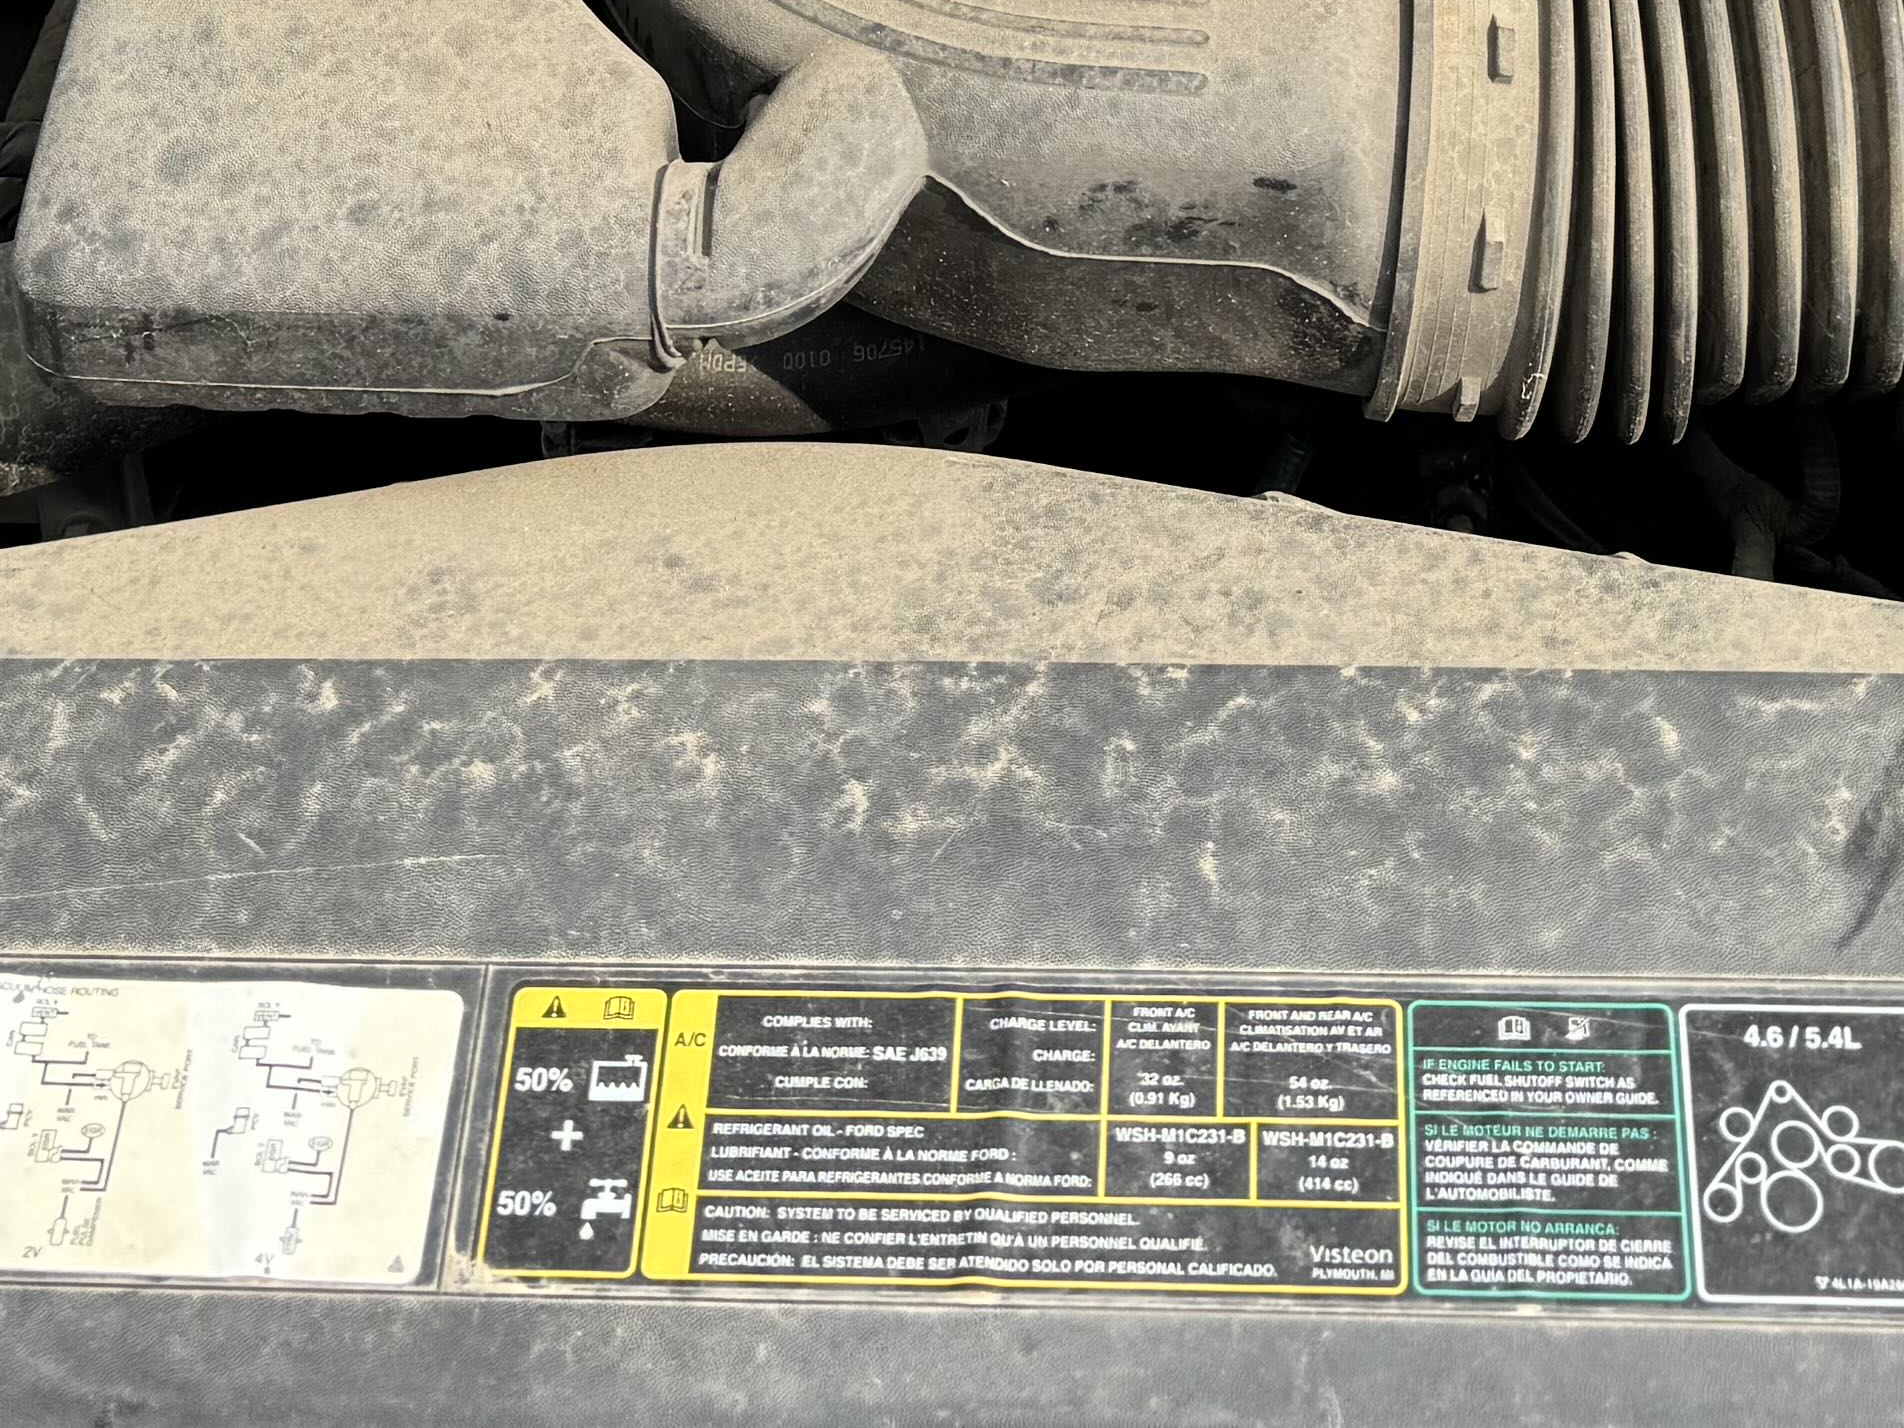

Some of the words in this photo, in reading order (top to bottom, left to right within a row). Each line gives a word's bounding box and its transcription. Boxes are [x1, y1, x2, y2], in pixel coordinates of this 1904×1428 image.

[70, 987, 119, 997] ROUTING
[1133, 1007, 1172, 1018] FRONT
[1175, 1007, 1195, 1019] A/C
[1248, 1010, 1287, 1021] FRONT
[1290, 1010, 1316, 1021] AND
[1318, 1010, 1351, 1022] REAR
[762, 1015, 832, 1028] COMPLIES
[834, 1016, 872, 1029] WITH:
[990, 1017, 1047, 1031] CHARGE
[1049, 1019, 1096, 1032] LEVEL:
[674, 1032, 707, 1048] A/C
[1743, 1025, 1790, 1048] 4.6
[1804, 1026, 1862, 1049] 5.4L
[719, 1044, 789, 1058] CONFORME
[802, 1046, 820, 1058] LA
[873, 1046, 906, 1061] SAE
[910, 1046, 947, 1062] J639
[1033, 1049, 1095, 1062] CHARGE:
[1423, 1059, 1434, 1071] IF
[1438, 1059, 1490, 1072] ENGINE
[1493, 1059, 1532, 1072] FAILS
[1536, 1059, 1555, 1072] TO
[1558, 1060, 1605, 1073] START:
[514, 1067, 574, 1093] 50%
[775, 1076, 831, 1089] CUMPLE
[834, 1076, 868, 1089] CON:
[965, 1077, 1008, 1091] CARGA
[1011, 1078, 1028, 1090] DE
[1030, 1078, 1094, 1093] LLENADO:
[1142, 1073, 1159, 1086] 32
[1289, 1076, 1308, 1089] 54
[1422, 1074, 1467, 1087] CHECK
[1470, 1074, 1501, 1088] FUEL
[1504, 1075, 1563, 1088] SHUTOFF
[1565, 1075, 1616, 1089] SWITCH
[1618, 1076, 1636, 1089] AS
[1129, 1092, 1165, 1108] (0.91
[1167, 1092, 1195, 1108] Kg)
[1277, 1095, 1314, 1111] (1.53
[1317, 1095, 1345, 1111] Kg)
[1423, 1089, 1508, 1103] REFERENCED
[1511, 1090, 1523, 1103] IN
[1526, 1091, 1564, 1104] YOUR
[1567, 1091, 1612, 1105] OWNER
[1615, 1091, 1659, 1106] GUIDE.
[713, 1124, 809, 1137] REFRIGERANT
[812, 1125, 834, 1137] OIL
[845, 1126, 882, 1137] FORD
[886, 1126, 924, 1138] SPEC
[1115, 1128, 1246, 1145] WSH-M1C231-B
[1424, 1125, 1436, 1137] SI
[1439, 1125, 1457, 1137] LE
[1461, 1125, 1522, 1138] MOTEUR
[1525, 1126, 1545, 1138] NE
[1619, 1127, 1649, 1140] PAS
[1262, 1131, 1394, 1149] WSH-M1C231-B
[1492, 1140, 1510, 1154] LA
[1513, 1140, 1593, 1155] COMMANDE
[1598, 1142, 1619, 1155] DE
[1163, 1151, 1173, 1164] 9
[1177, 1154, 1195, 1164] oz
[1309, 1155, 1326, 1169] 14
[1330, 1158, 1348, 1169] oz
[1425, 1155, 1493, 1169] COUPURE
[1497, 1156, 1517, 1169] DE
[1615, 1157, 1669, 1172] COMME
[1149, 1173, 1181, 1189] (266
[1184, 1173, 1210, 1189] cc)
[1299, 1177, 1330, 1193] (414
[1334, 1177, 1359, 1193] cc)
[496, 1190, 557, 1217] 50%
[1426, 1188, 1555, 1203] L'AUTOMOBILISTE.
[704, 1206, 770, 1219] CAUTION:
[777, 1206, 833, 1220] SYSTEM
[836, 1207, 855, 1220] TO
[858, 1208, 877, 1220] BE
[880, 1208, 949, 1222] SERVICED
[953, 1209, 973, 1222] BY
[975, 1208, 1048, 1224] QUALIFIED
[1051, 1211, 1140, 1225] PERSONNEL.
[1427, 1220, 1439, 1233] SI
[1443, 1220, 1460, 1233] LE
[1464, 1221, 1517, 1234] MOTOR
[1520, 1221, 1542, 1235] NO
[1544, 1222, 1619, 1236] ARRANCA:
[1426, 1236, 1475, 1250] REVISE
[1478, 1237, 1496, 1250] EL
[1499, 1237, 1593, 1251] INTERRUPTOR
[1597, 1238, 1617, 1251] DE
[1620, 1238, 1672, 1253] CIERRE
[1309, 1246, 1393, 1265] Visteon
[801, 1255, 818, 1268] EL
[821, 1255, 883, 1269] SISTEMA
[887, 1256, 925, 1269] DEBE
[928, 1256, 956, 1270] SER
[958, 1257, 1029, 1272] ATENDIDO
[1032, 1260, 1067, 1273] SOLO
[1071, 1261, 1106, 1274] POR
[1109, 1261, 1185, 1275] PERSONAL
[1188, 1262, 1277, 1277] CALIFICADO.
